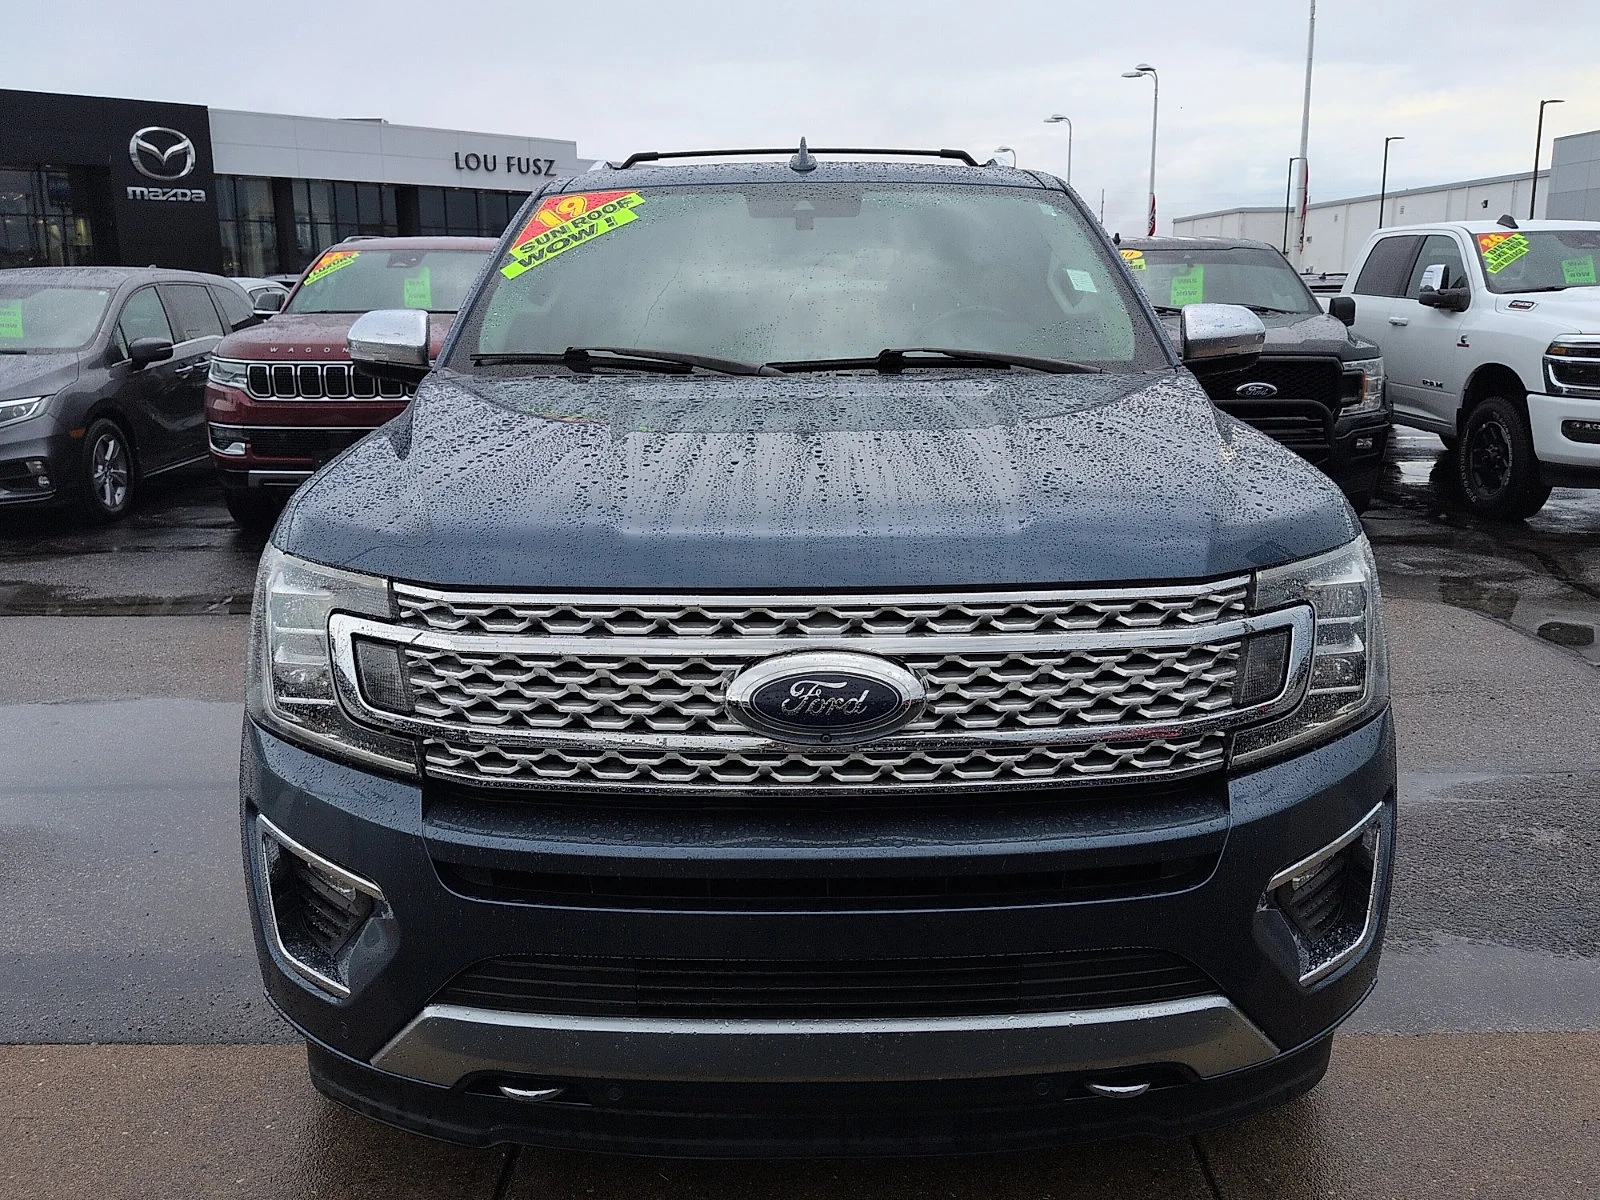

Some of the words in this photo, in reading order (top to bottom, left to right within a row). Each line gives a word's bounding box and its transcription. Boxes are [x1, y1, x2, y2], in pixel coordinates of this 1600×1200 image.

[455, 152, 496, 172] LOU
[506, 156, 557, 177] FUSZ
[519, 225, 568, 254] SUN
[571, 196, 634, 229] ROOF
[536, 195, 588, 228] 19
[518, 223, 599, 268] WOW
[781, 680, 869, 716] Ford
